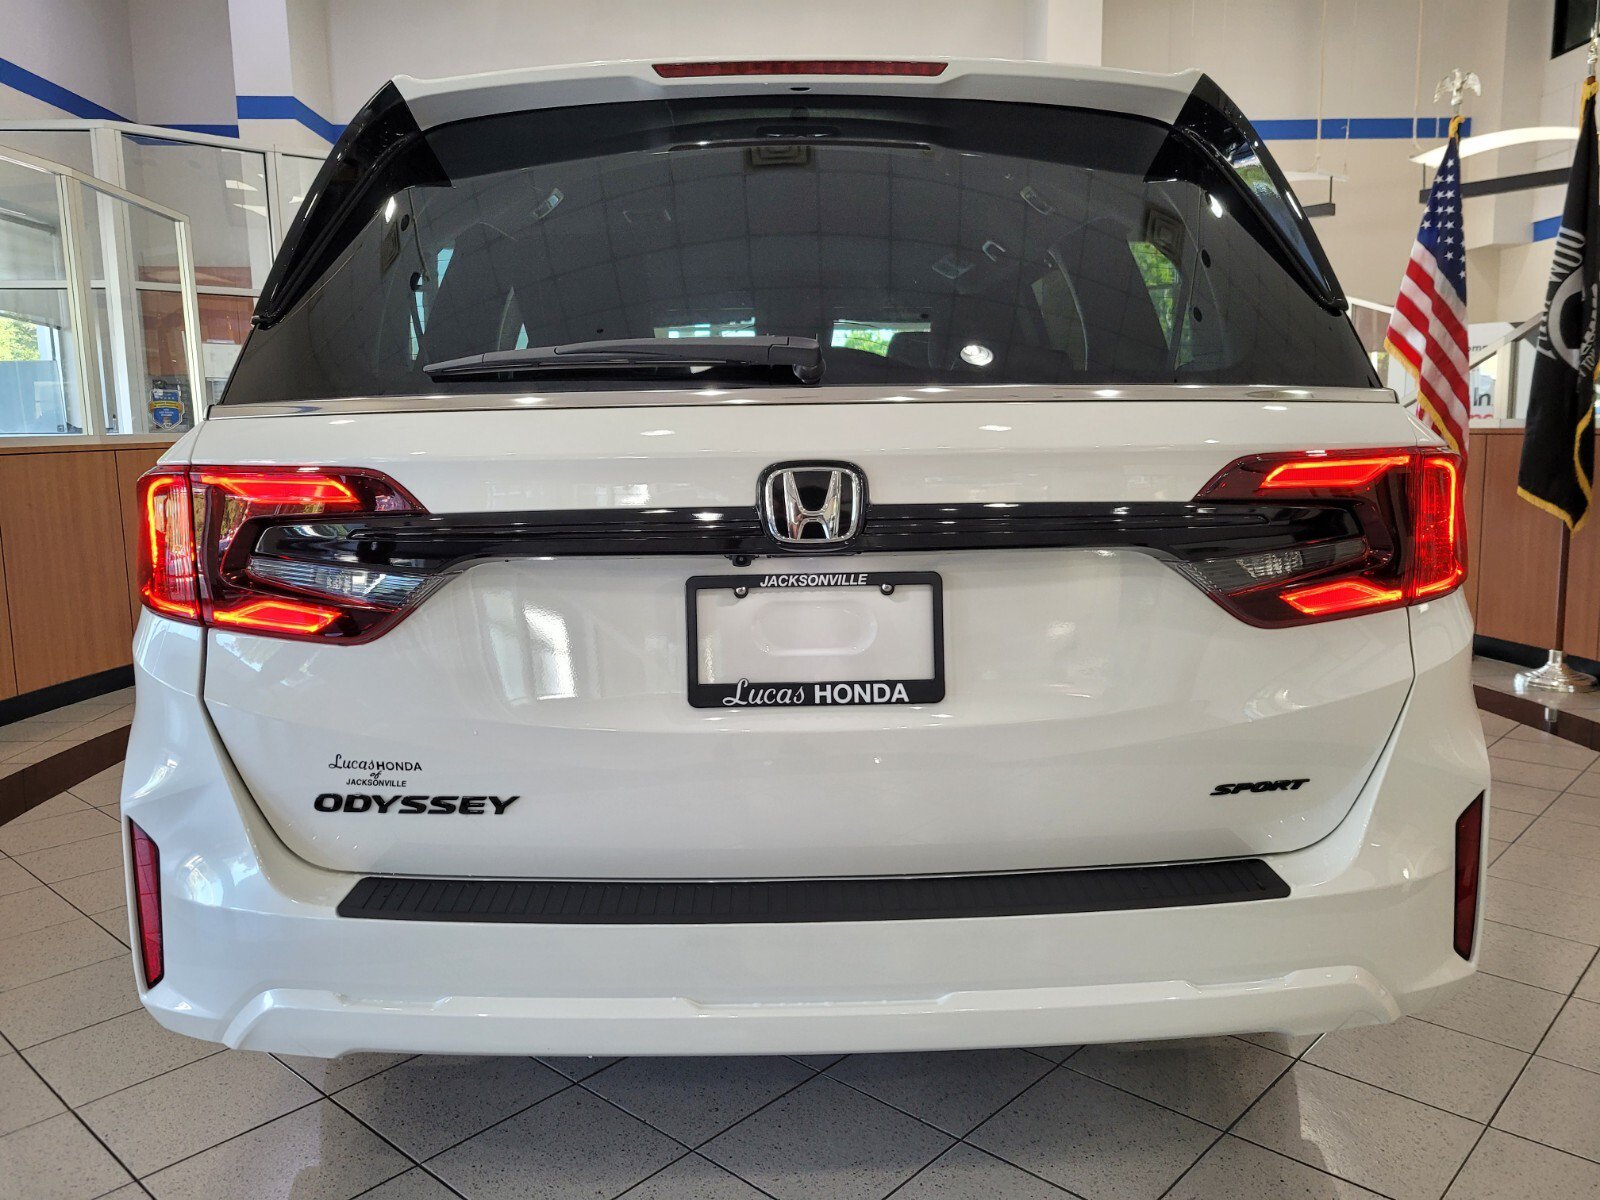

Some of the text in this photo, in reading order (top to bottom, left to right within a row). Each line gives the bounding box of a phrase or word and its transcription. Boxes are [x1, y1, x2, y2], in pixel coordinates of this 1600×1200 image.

[759, 573, 868, 588] JACKSONVILLE
[722, 678, 910, 706] Lucas HONDA
[328, 753, 423, 772] Lucas HONDA
[346, 778, 407, 788] JACKSONVILLE
[369, 770, 382, 779] of
[1209, 778, 1311, 796] SPORT
[313, 792, 521, 815] ODYSSEY
